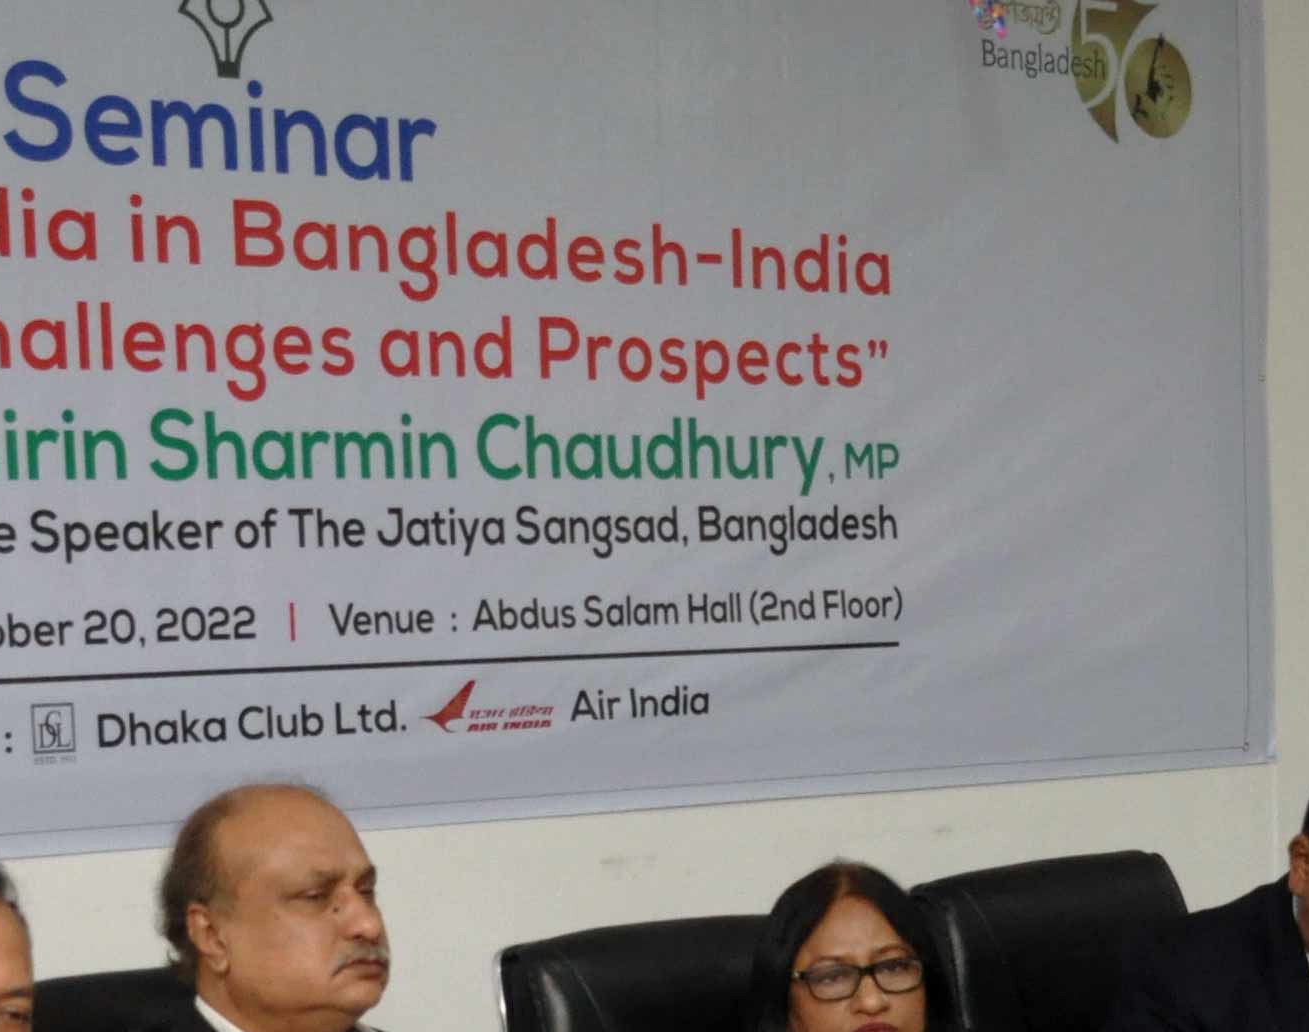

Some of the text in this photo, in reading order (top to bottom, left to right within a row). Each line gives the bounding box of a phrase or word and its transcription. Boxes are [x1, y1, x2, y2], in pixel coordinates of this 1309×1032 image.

[981, 39, 1107, 80] Bangladesh
[3, 59, 437, 182] Seminar
[130, 194, 200, 265] in
[233, 199, 891, 302] Bangladesh-India
[380, 315, 512, 379] and
[150, 408, 457, 482] Sharmin
[477, 413, 834, 496] Chaudhury,
[845, 443, 900, 479] MP
[30, 509, 223, 564] Speaker
[235, 508, 279, 549] of
[288, 508, 366, 549] The
[377, 507, 506, 556] Jatiya
[516, 505, 689, 558] Sangsad,
[698, 504, 898, 556] Bangladesh
[84, 609, 146, 648] 20,
[156, 605, 257, 643] 2022
[328, 603, 435, 637] Venue
[473, 598, 576, 631] Abdus
[584, 595, 679, 628] Salam
[688, 592, 742, 625] Hall
[750, 590, 816, 625] (2nd
[823, 586, 903, 622] Floor)
[97, 710, 227, 749] Dhaka
[238, 704, 325, 741] Club
[335, 700, 407, 735] Ltd.
[570, 689, 621, 722] Air
[630, 685, 710, 719] India
[467, 719, 552, 733] AIR INDIA
